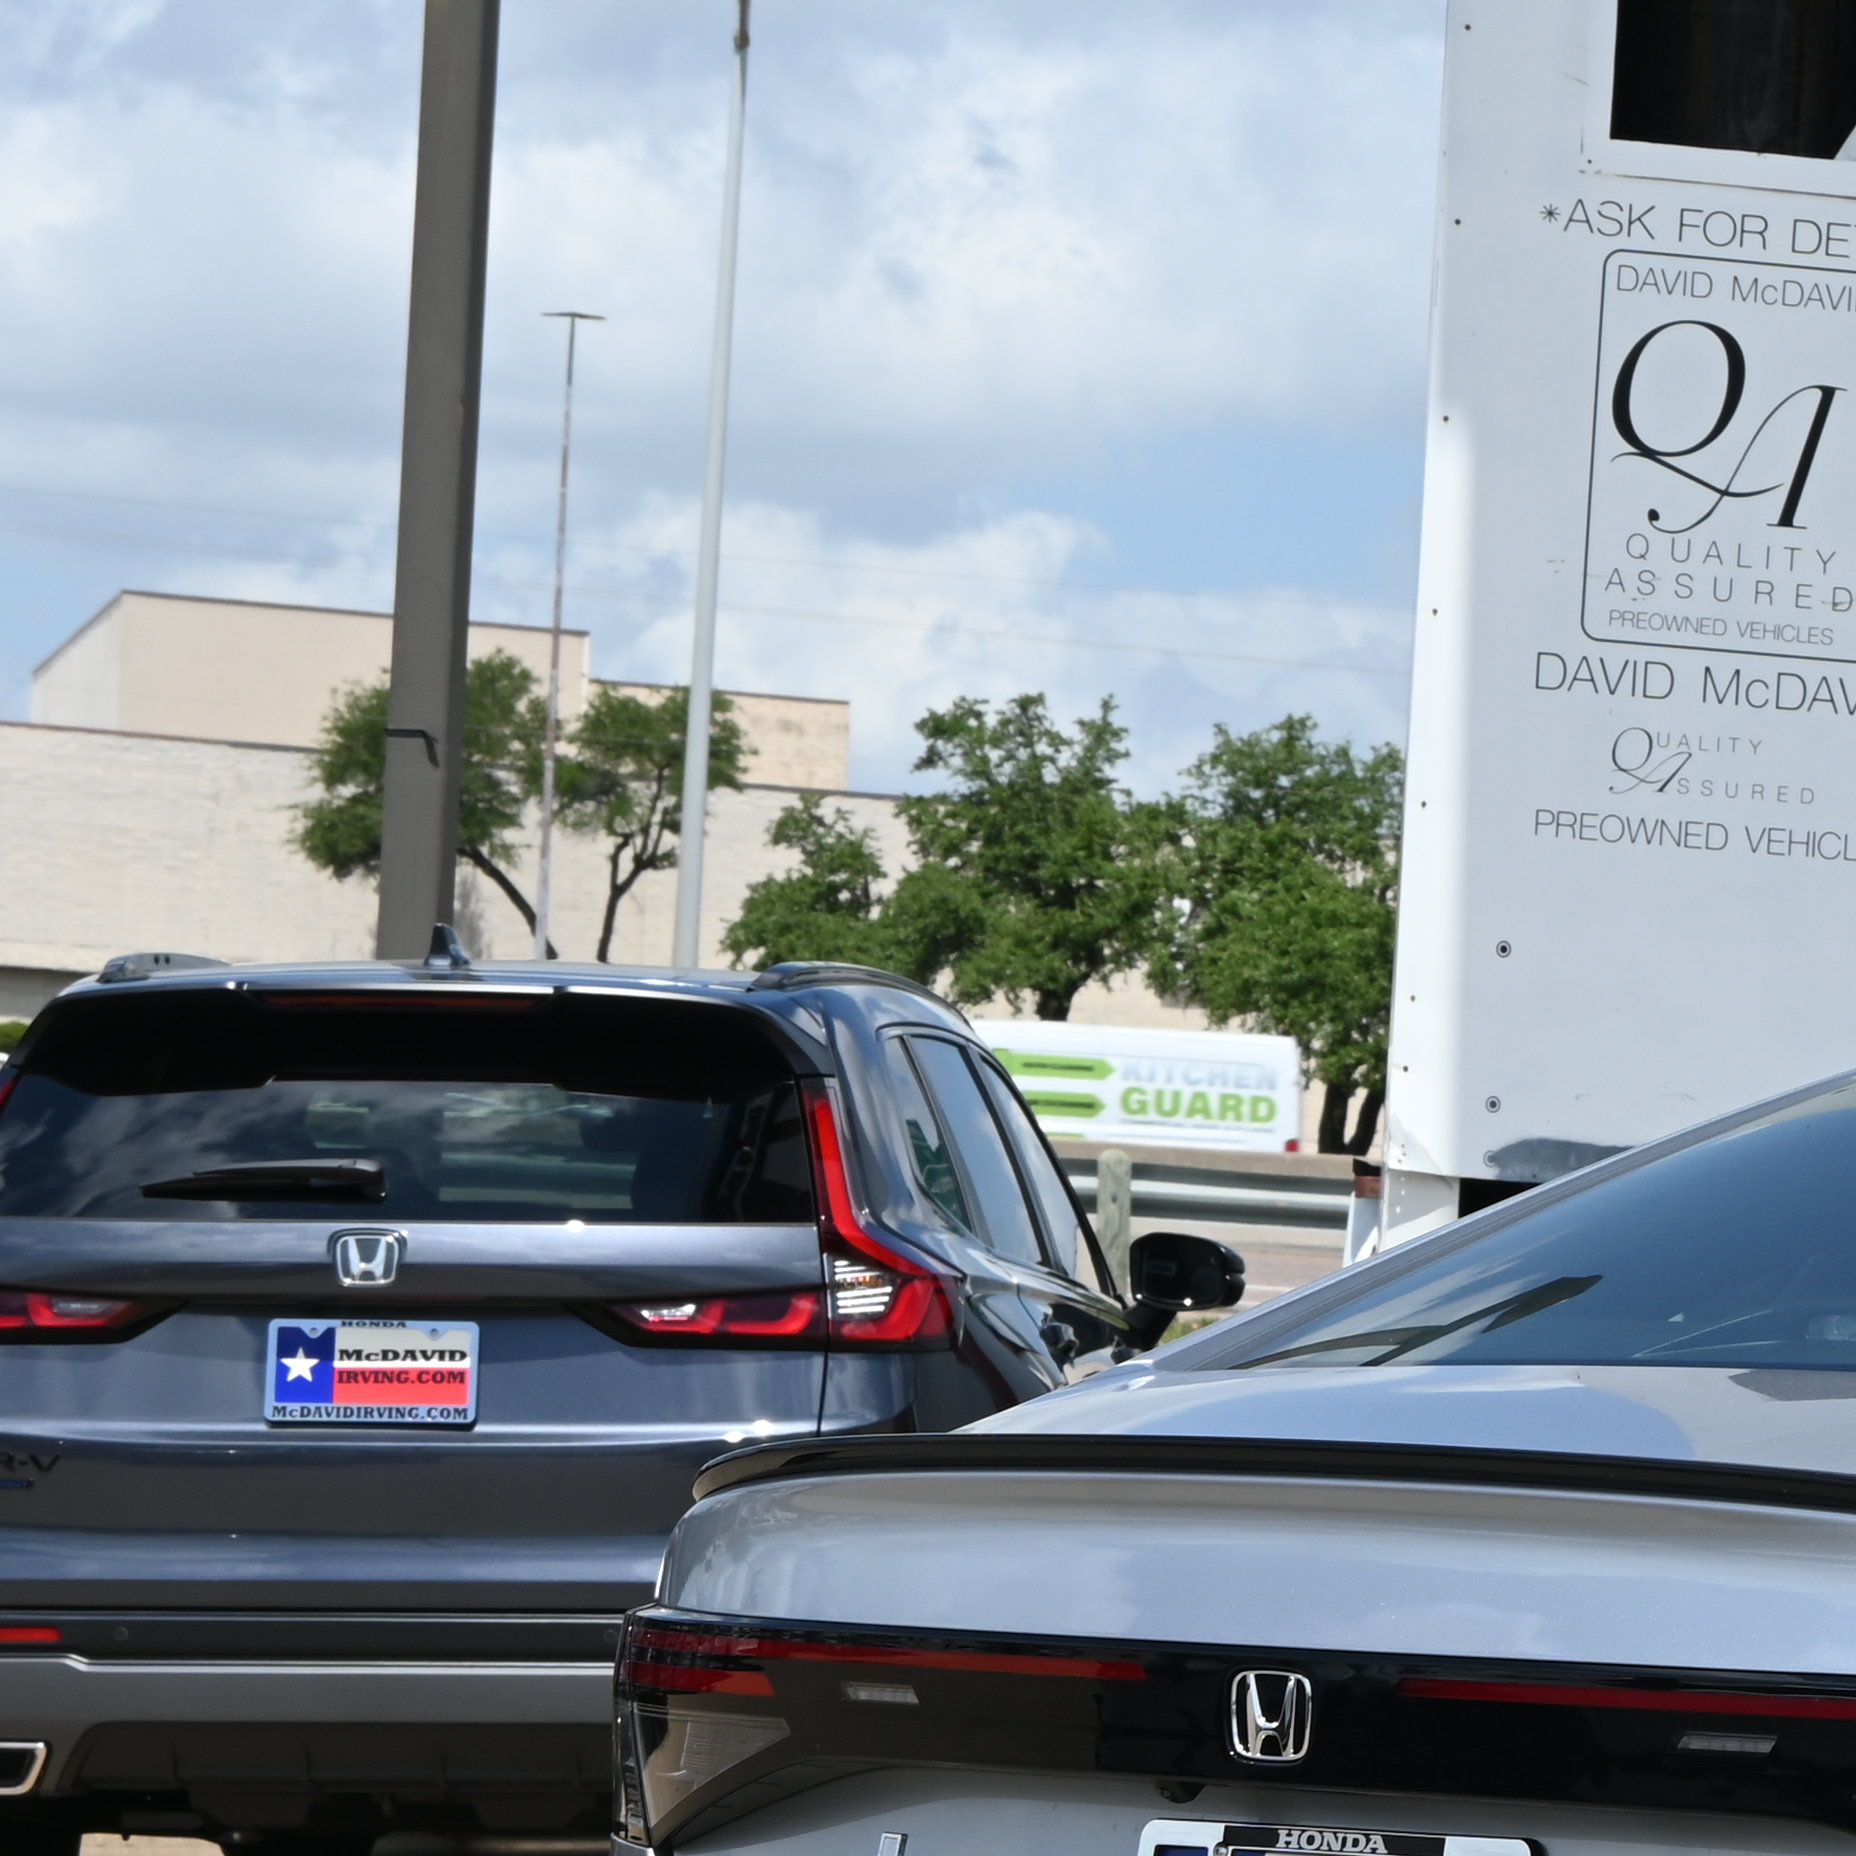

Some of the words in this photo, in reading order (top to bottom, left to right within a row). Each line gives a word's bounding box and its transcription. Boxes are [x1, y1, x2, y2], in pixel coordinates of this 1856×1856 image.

[1678, 209, 1769, 252] FOR
[1616, 264, 1714, 301] DAVID
[1626, 533, 1836, 577] QUALITY
[1605, 567, 1856, 613] ASSURED
[1608, 608, 1728, 641] PREOWNED
[1736, 619, 1834, 646] VEHICLES
[1534, 652, 1674, 700] DAVID
[1611, 726, 1764, 774] QUALITY
[1534, 808, 1728, 853] PREOWNED
[1122, 1062, 1278, 1090] KITCHEN
[1121, 1087, 1276, 1123] GUARD
[341, 1320, 407, 1328] HONDA
[338, 1349, 467, 1362] McDAVID
[337, 1371, 465, 1385] IRVING.COM
[271, 1405, 468, 1420] McDAVIDIRVING.COM
[0, 1452, 61, 1472] R-V
[1274, 1829, 1388, 1854] HONDA
